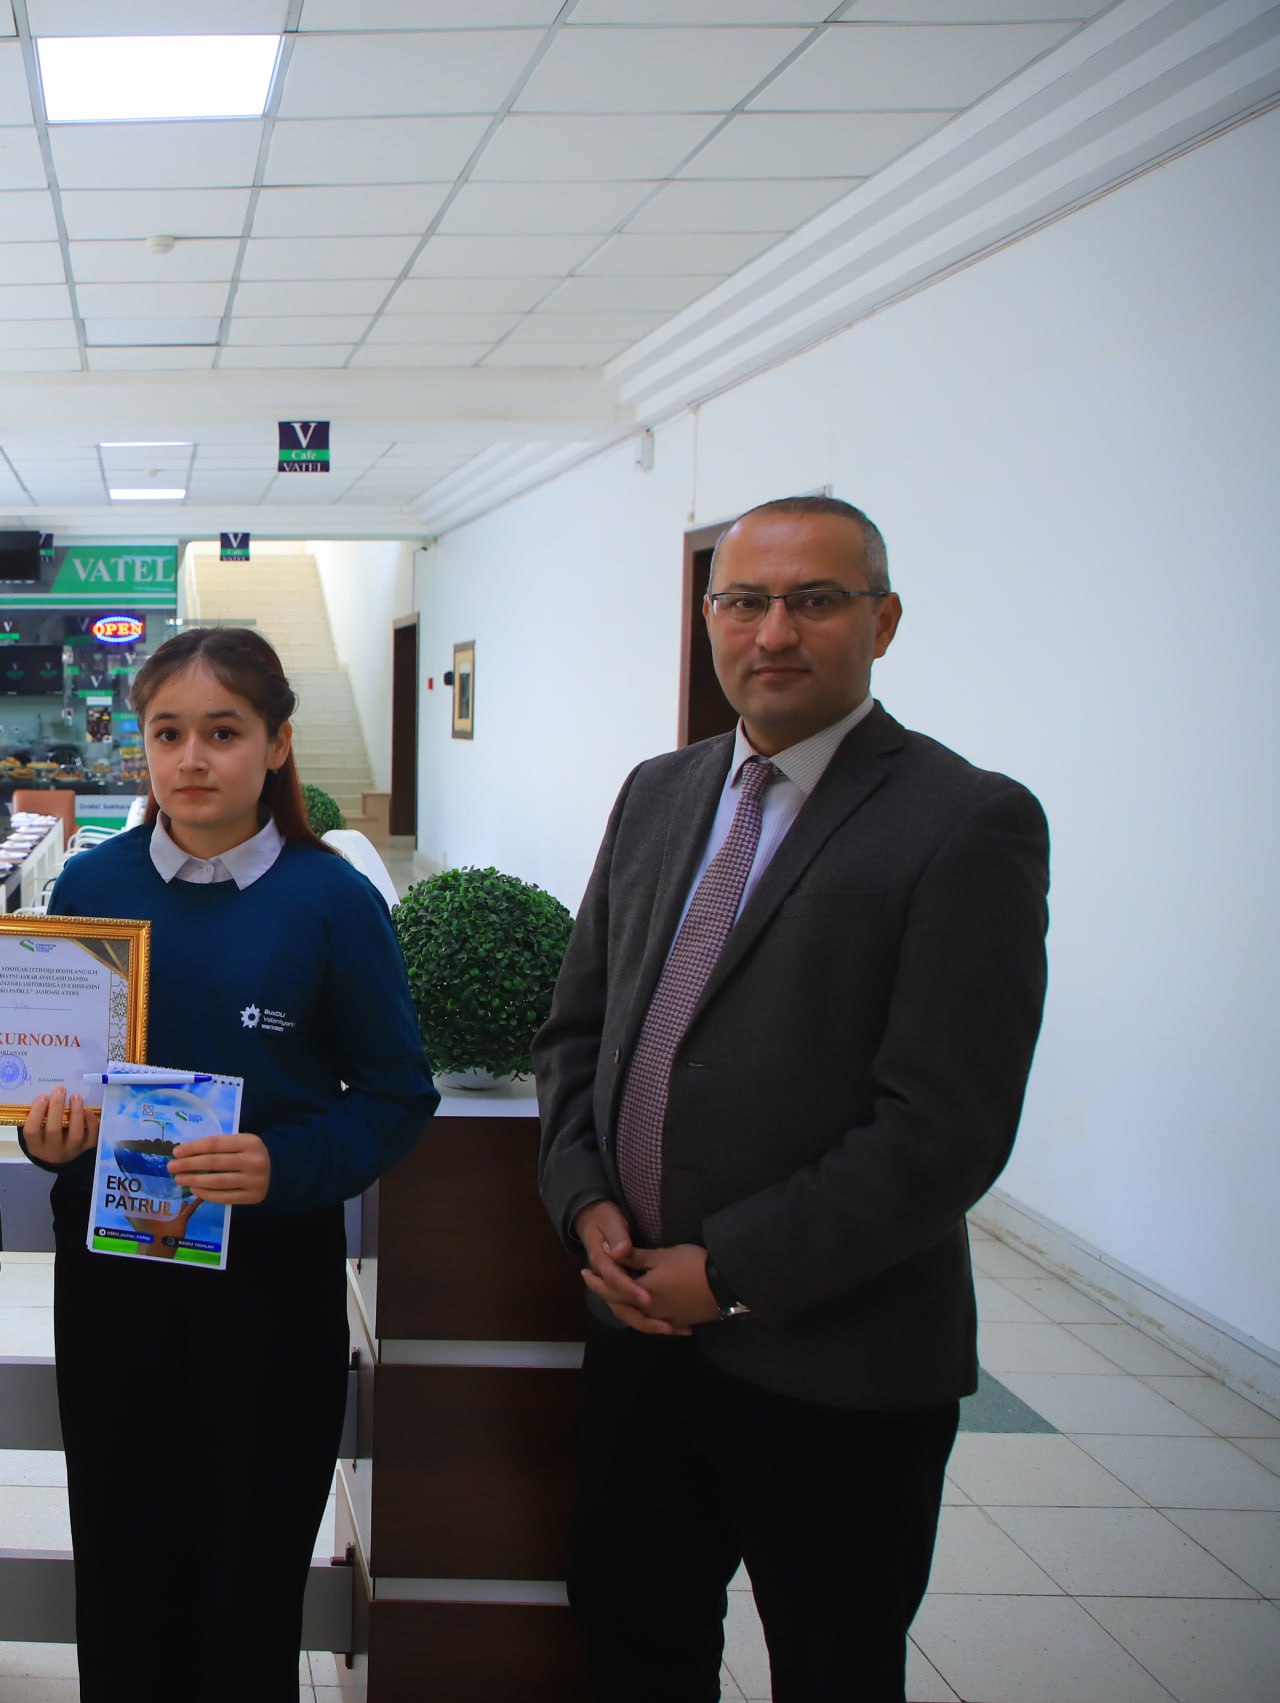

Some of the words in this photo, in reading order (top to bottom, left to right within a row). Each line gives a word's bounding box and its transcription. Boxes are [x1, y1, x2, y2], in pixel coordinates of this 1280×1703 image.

[290, 422, 318, 449] V
[291, 450, 317, 460] Cafe
[72, 556, 175, 583] VATEL
[92, 622, 144, 636] OPEN
[106, 1175, 142, 1192] EKO
[105, 1193, 173, 1217] PATRUL
